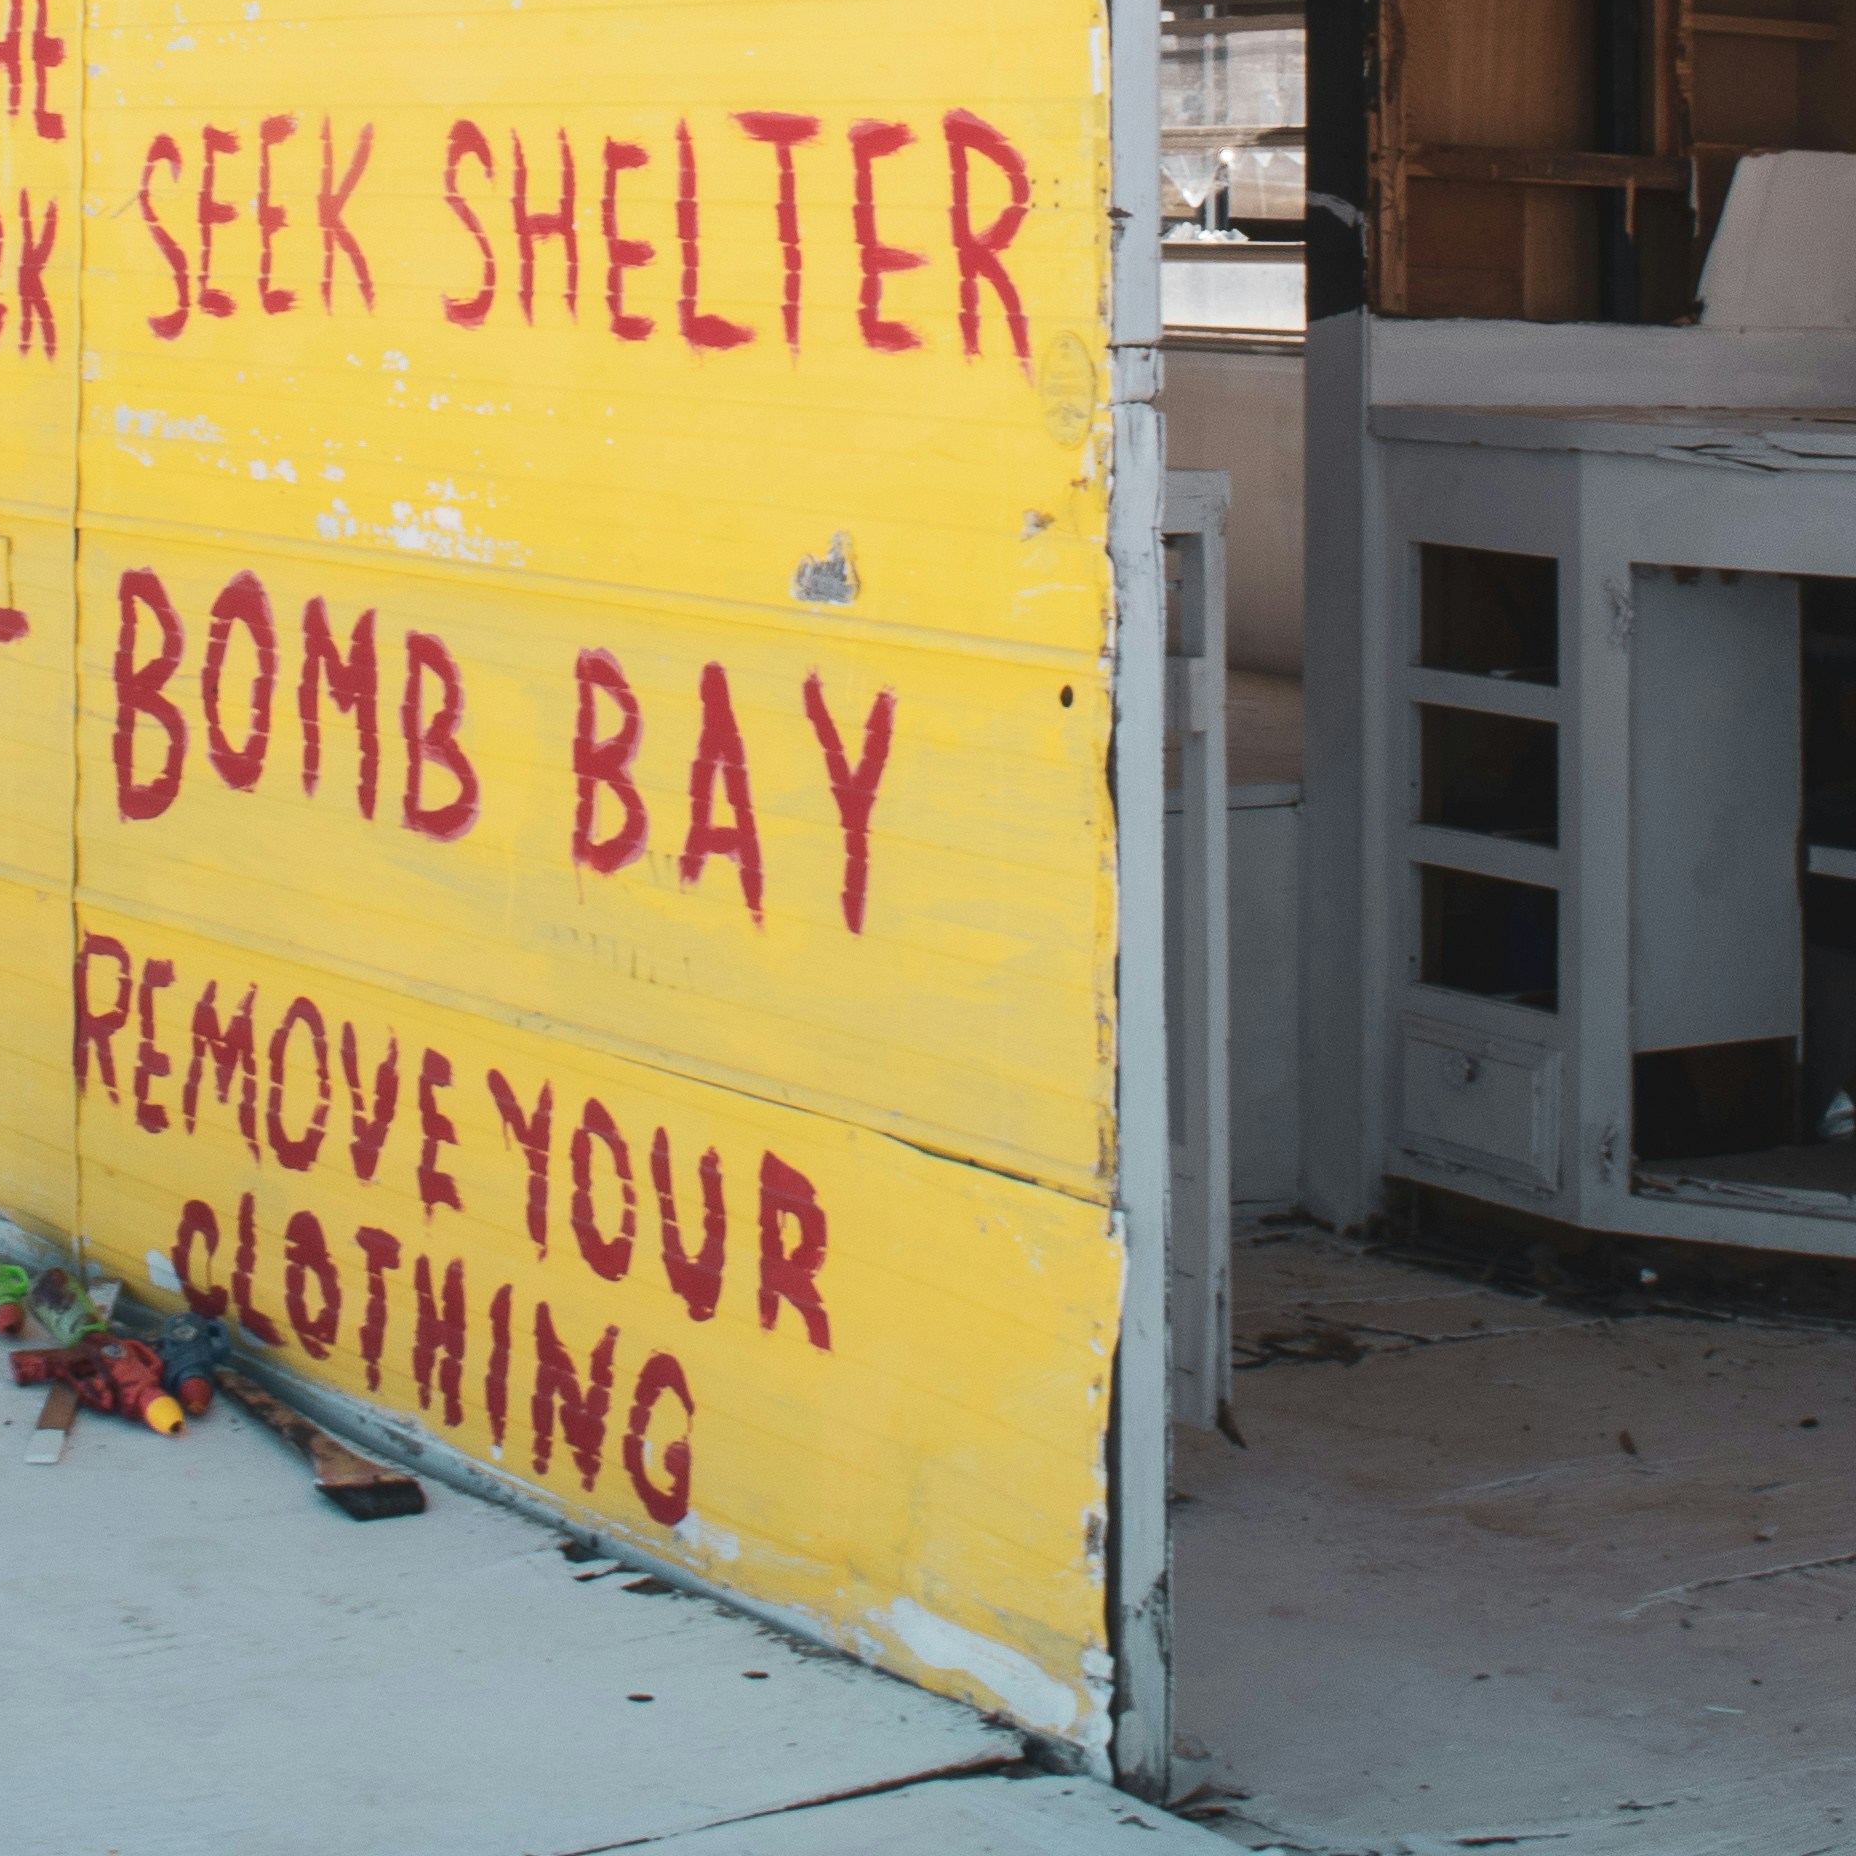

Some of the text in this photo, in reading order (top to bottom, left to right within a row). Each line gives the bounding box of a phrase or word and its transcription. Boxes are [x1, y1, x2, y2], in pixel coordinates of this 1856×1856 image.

[139, 108, 1036, 388] SEEK SHELTER
[110, 567, 899, 938] BOMB BAY
[72, 930, 833, 1354] REMOVE YOUR
[170, 1192, 697, 1528] CLOTHING
